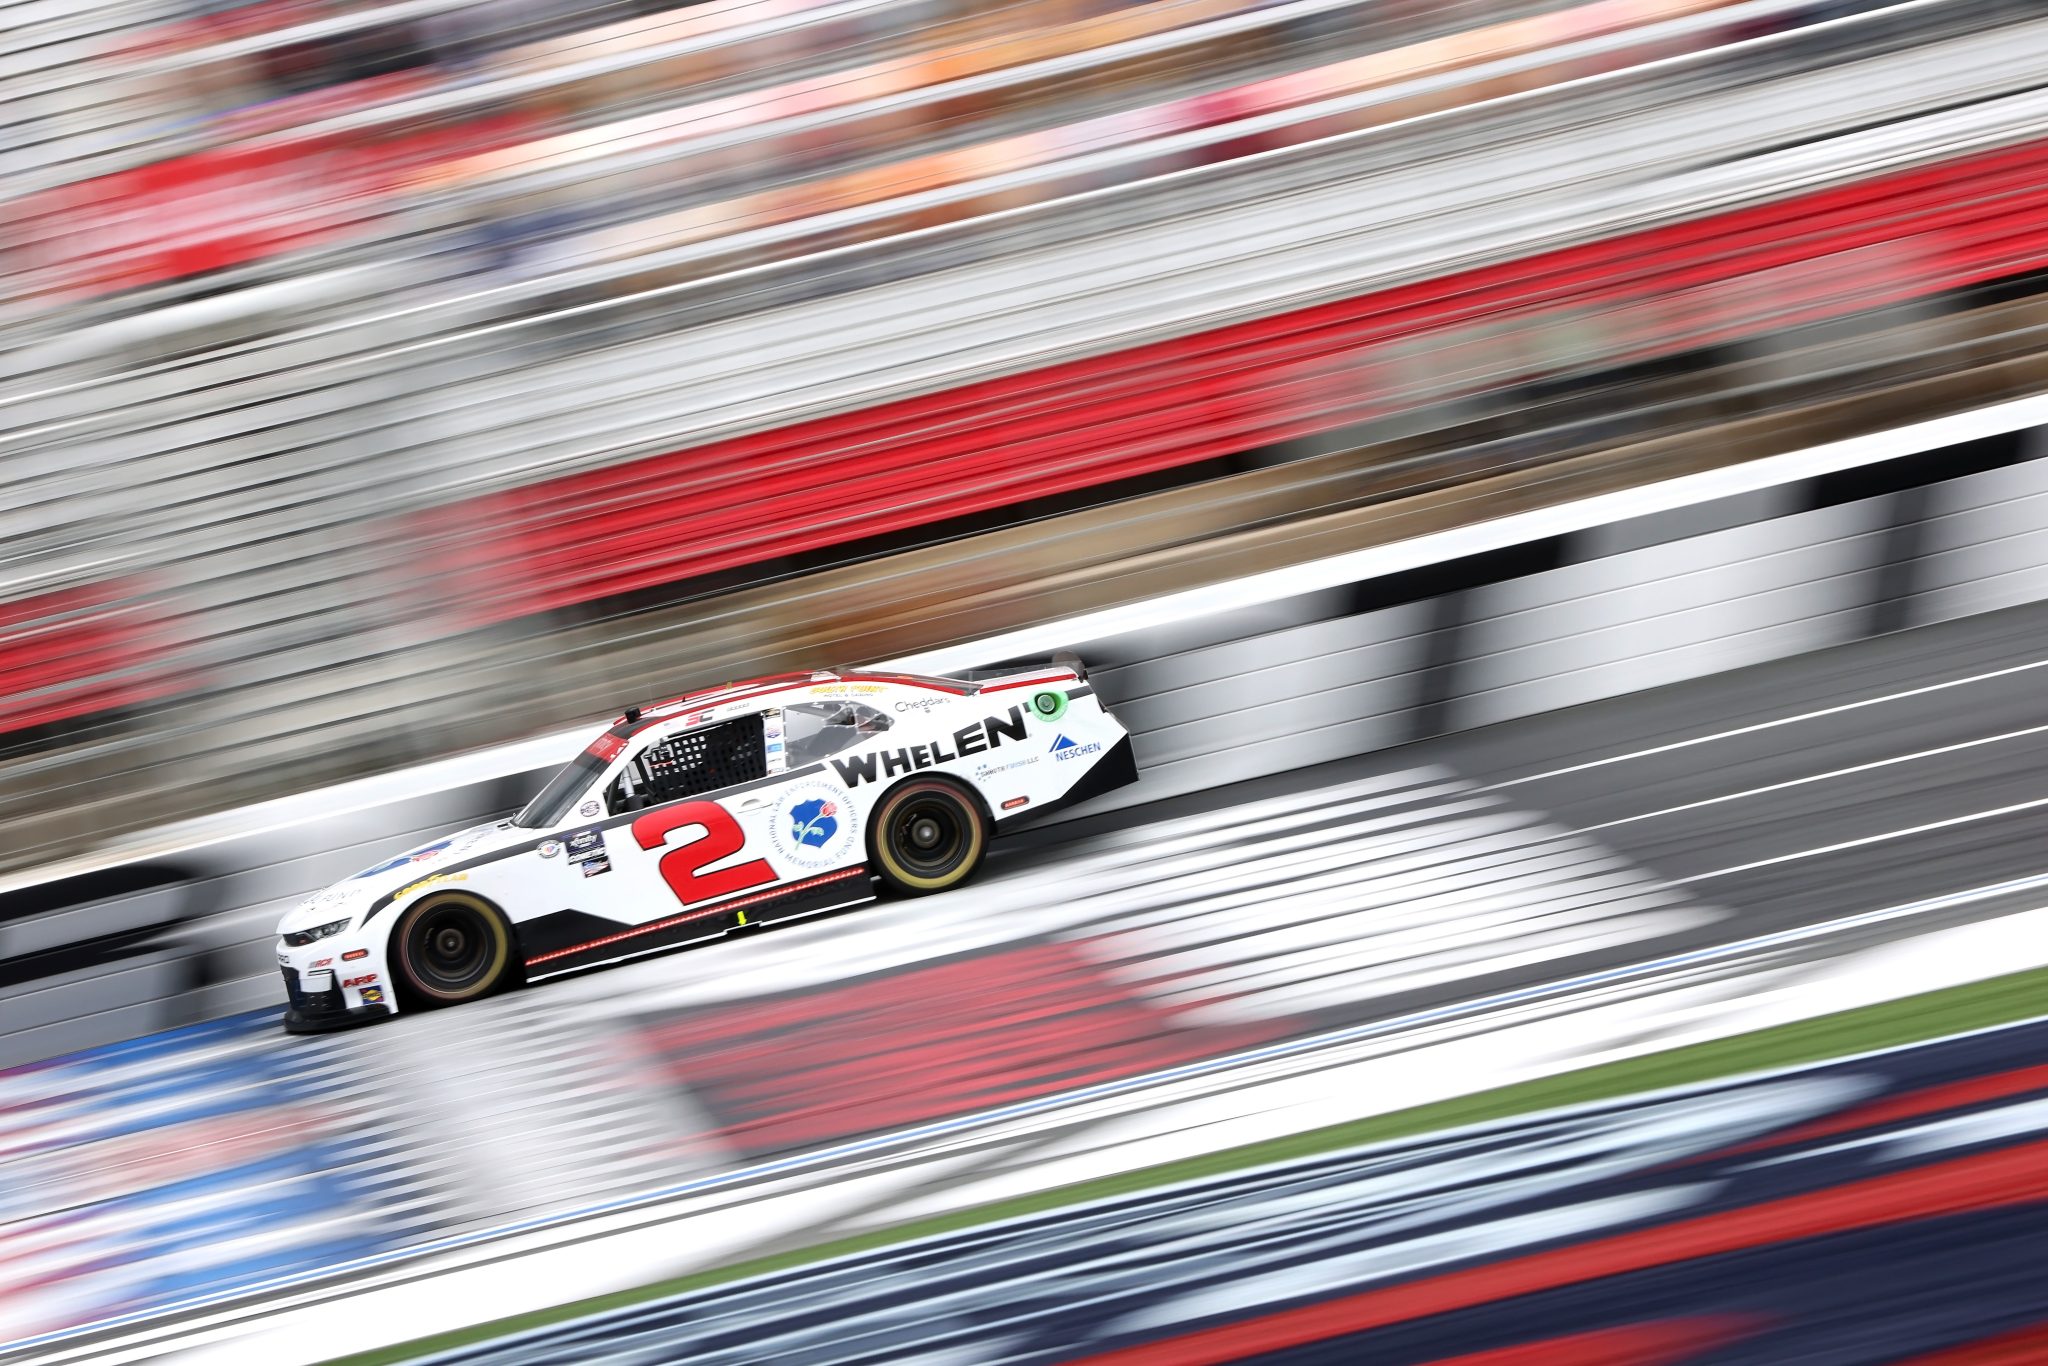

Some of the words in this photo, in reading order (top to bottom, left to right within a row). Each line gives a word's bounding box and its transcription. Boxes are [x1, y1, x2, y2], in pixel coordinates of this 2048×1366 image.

[829, 702, 1028, 789] WHELEN
[1055, 742, 1102, 762] NESCHEN
[842, 796, 858, 834] OFFICERS
[631, 801, 779, 907] 2
[342, 974, 379, 989] ARP
